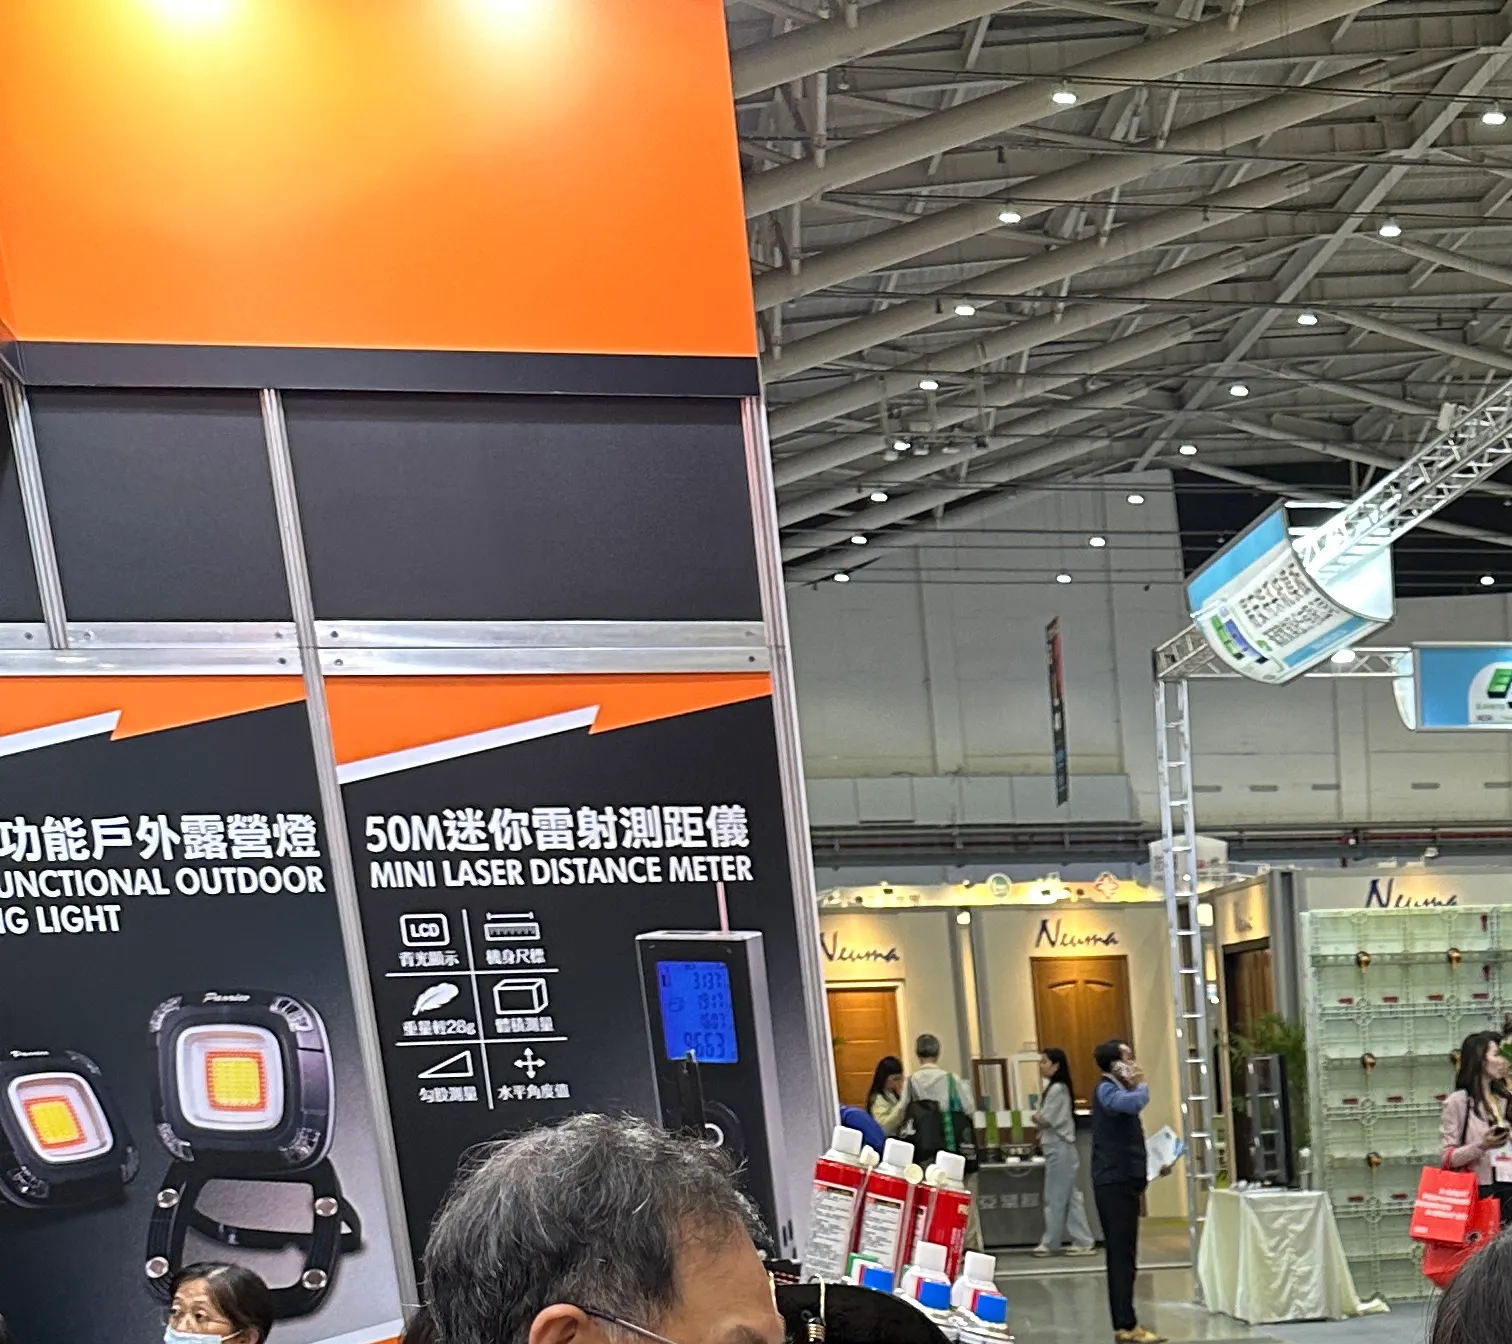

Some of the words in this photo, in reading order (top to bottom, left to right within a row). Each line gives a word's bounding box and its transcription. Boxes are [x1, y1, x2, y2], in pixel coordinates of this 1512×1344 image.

[0, 814, 321, 862] 功能戶外露營燈
[365, 804, 750, 853] 50M迷你雷射測距儀
[175, 865, 326, 895] OUTDOOR
[370, 860, 436, 888] MINI
[444, 858, 525, 887] LASER
[530, 856, 663, 885] DISTANCE
[669, 855, 754, 883] METER
[36, 904, 121, 933] LIGHT
[410, 923, 440, 938] LCD
